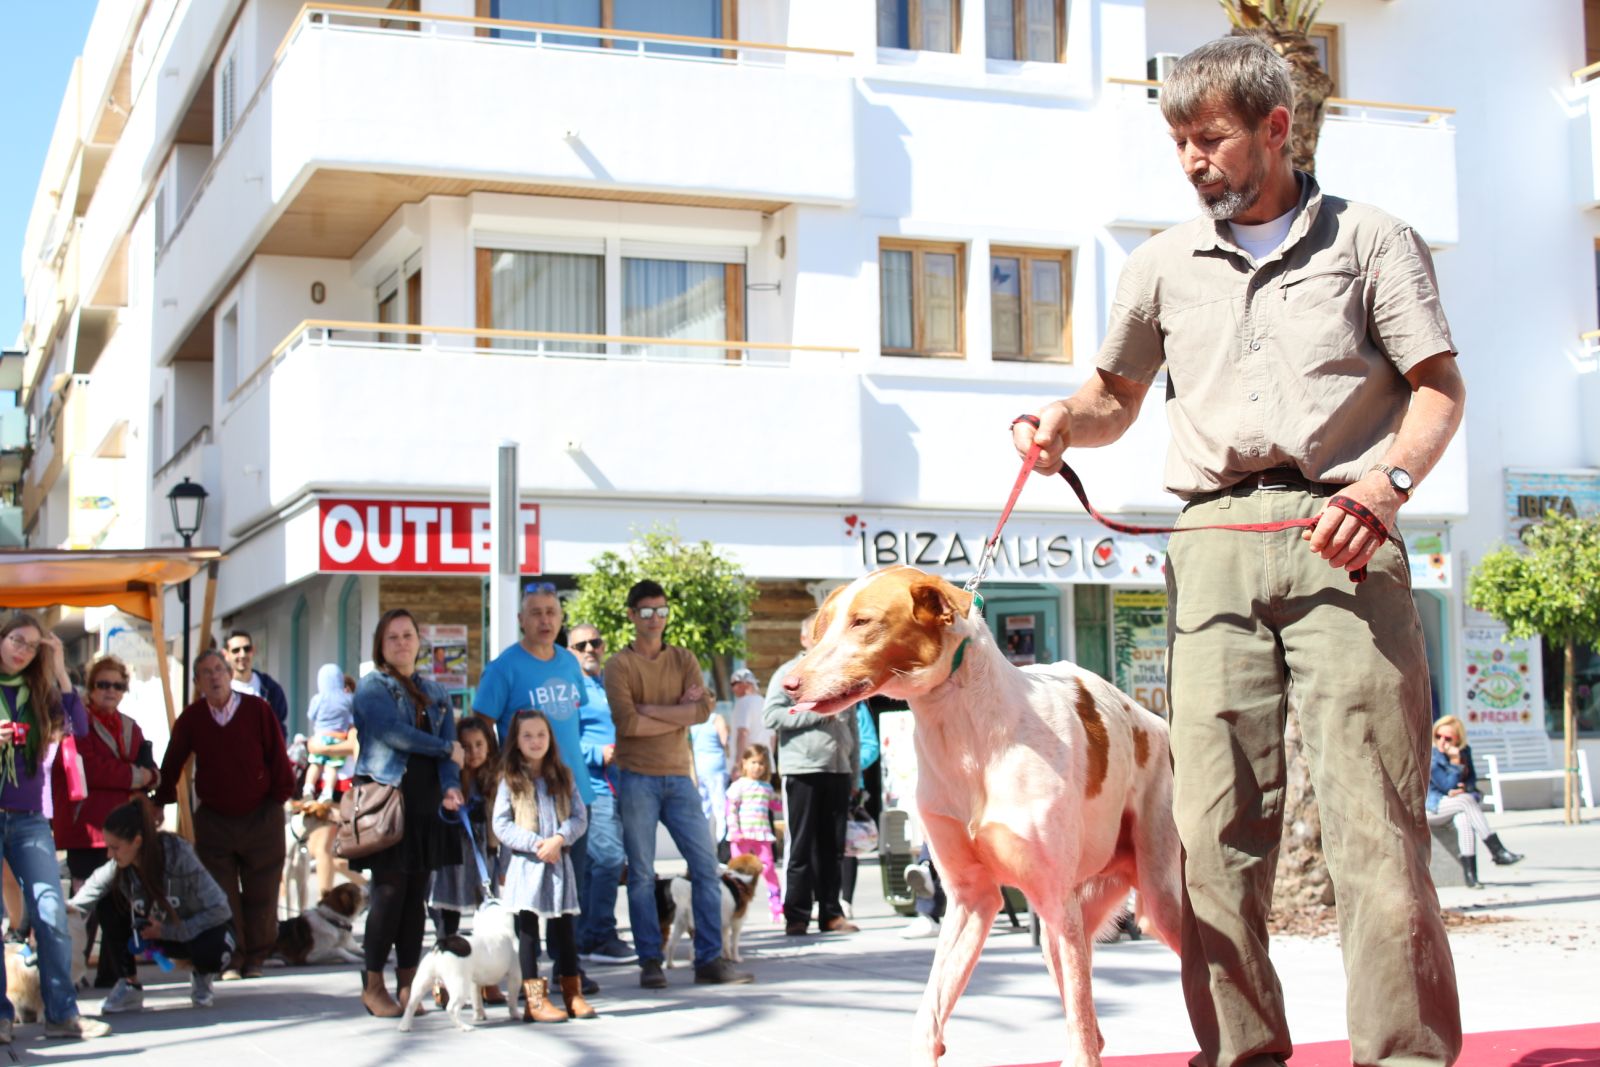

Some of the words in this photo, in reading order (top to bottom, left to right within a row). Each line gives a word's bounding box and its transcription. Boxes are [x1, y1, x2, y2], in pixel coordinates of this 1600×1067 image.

[1517, 495, 1578, 519] IBIZA
[322, 504, 536, 564] OUTLET
[858, 531, 971, 567] IBIZA
[977, 534, 1116, 571] MUSIC
[528, 684, 581, 707] IBIZA
